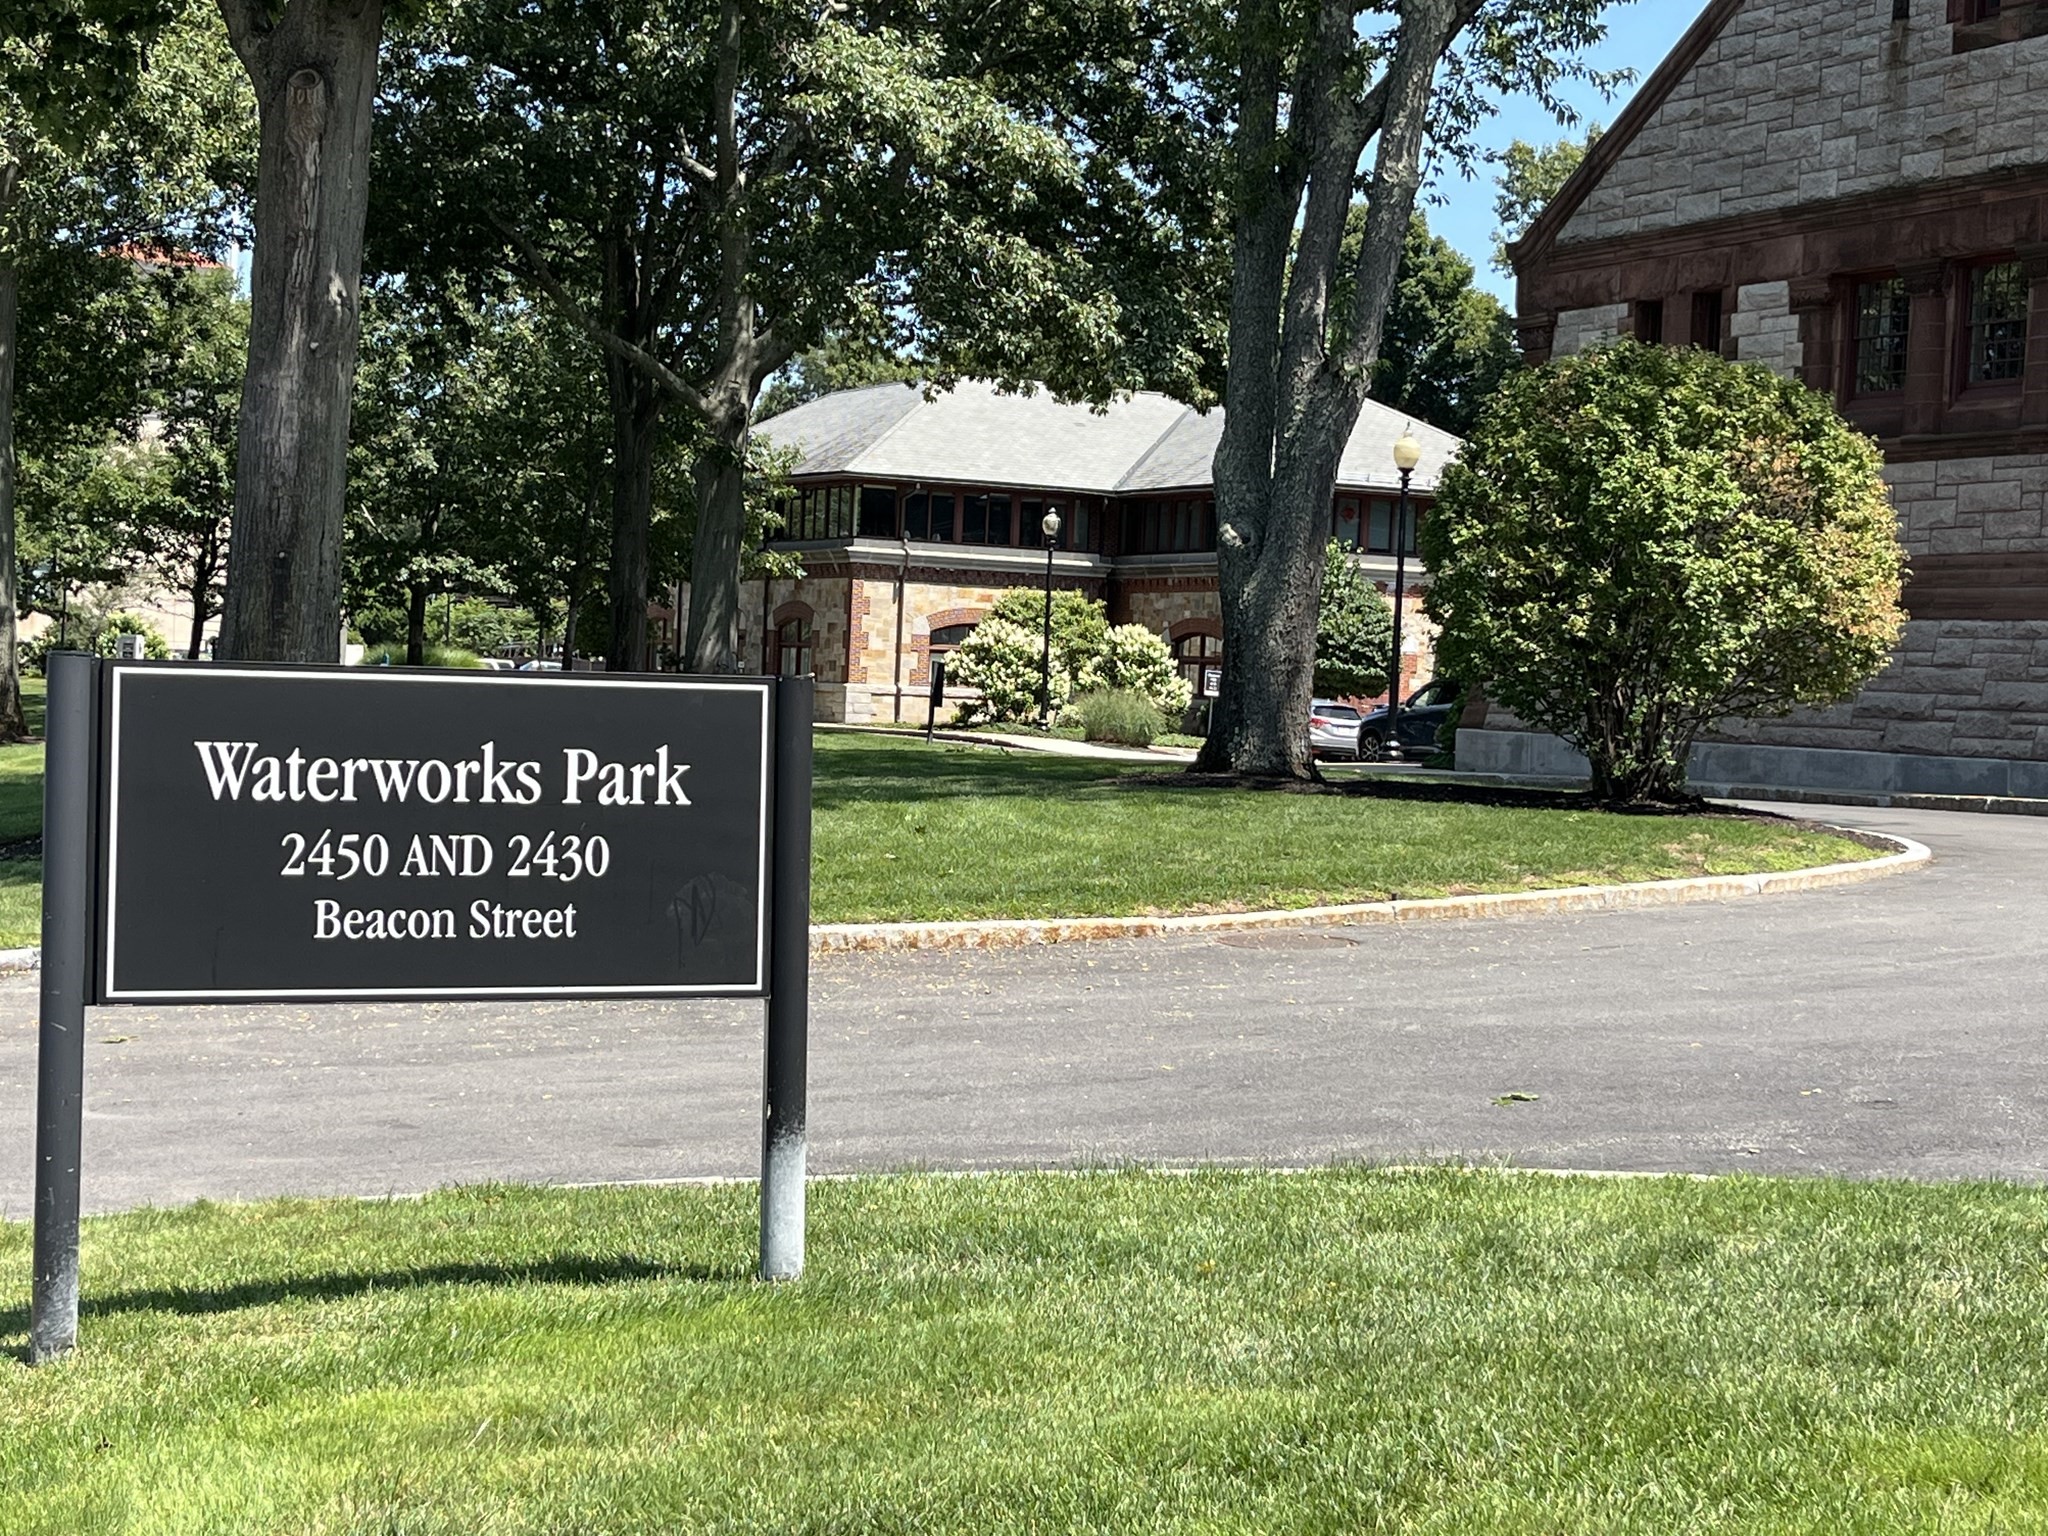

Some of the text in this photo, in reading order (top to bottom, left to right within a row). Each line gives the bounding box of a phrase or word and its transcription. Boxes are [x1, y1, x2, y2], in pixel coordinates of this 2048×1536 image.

[194, 741, 692, 806] Waterworks Park
[280, 829, 610, 882] 2450 AND 2430
[314, 899, 577, 940] Beacon Street
